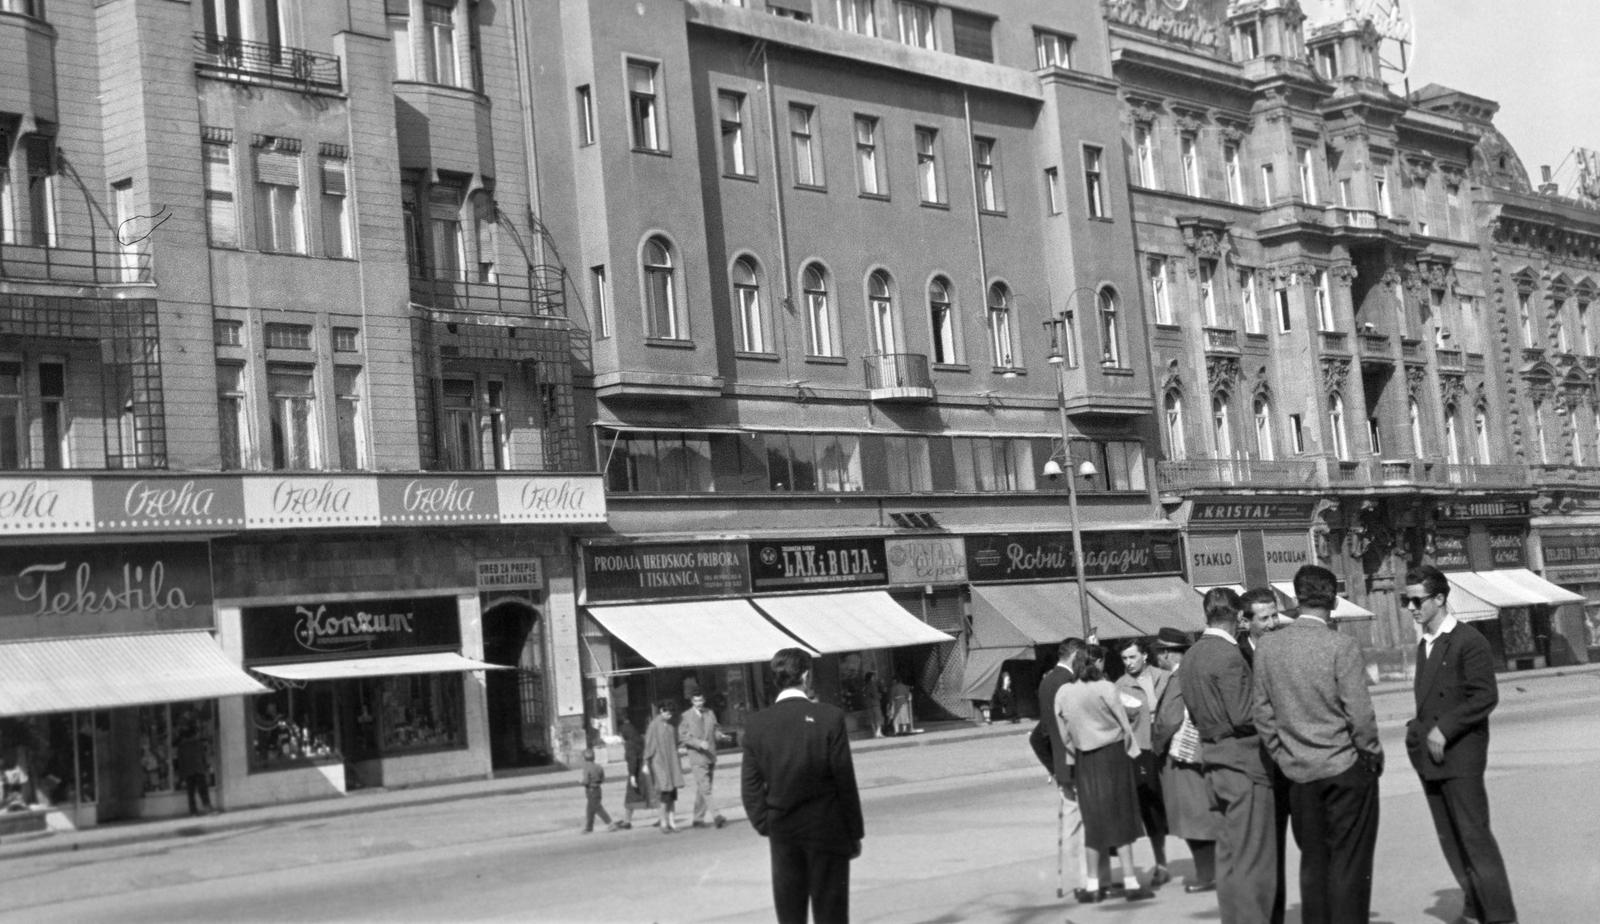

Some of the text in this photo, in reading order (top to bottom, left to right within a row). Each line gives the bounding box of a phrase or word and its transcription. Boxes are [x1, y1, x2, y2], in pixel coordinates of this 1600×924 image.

[594, 552, 740, 571] PRODAJA UREDSKOG PRIBORA
[782, 549, 873, 577] LAK i BOJA
[1194, 553, 1232, 566] STAKLO
[639, 572, 644, 587] I
[645, 571, 700, 587] TISKANICA
[15, 561, 196, 617] Tekstila
